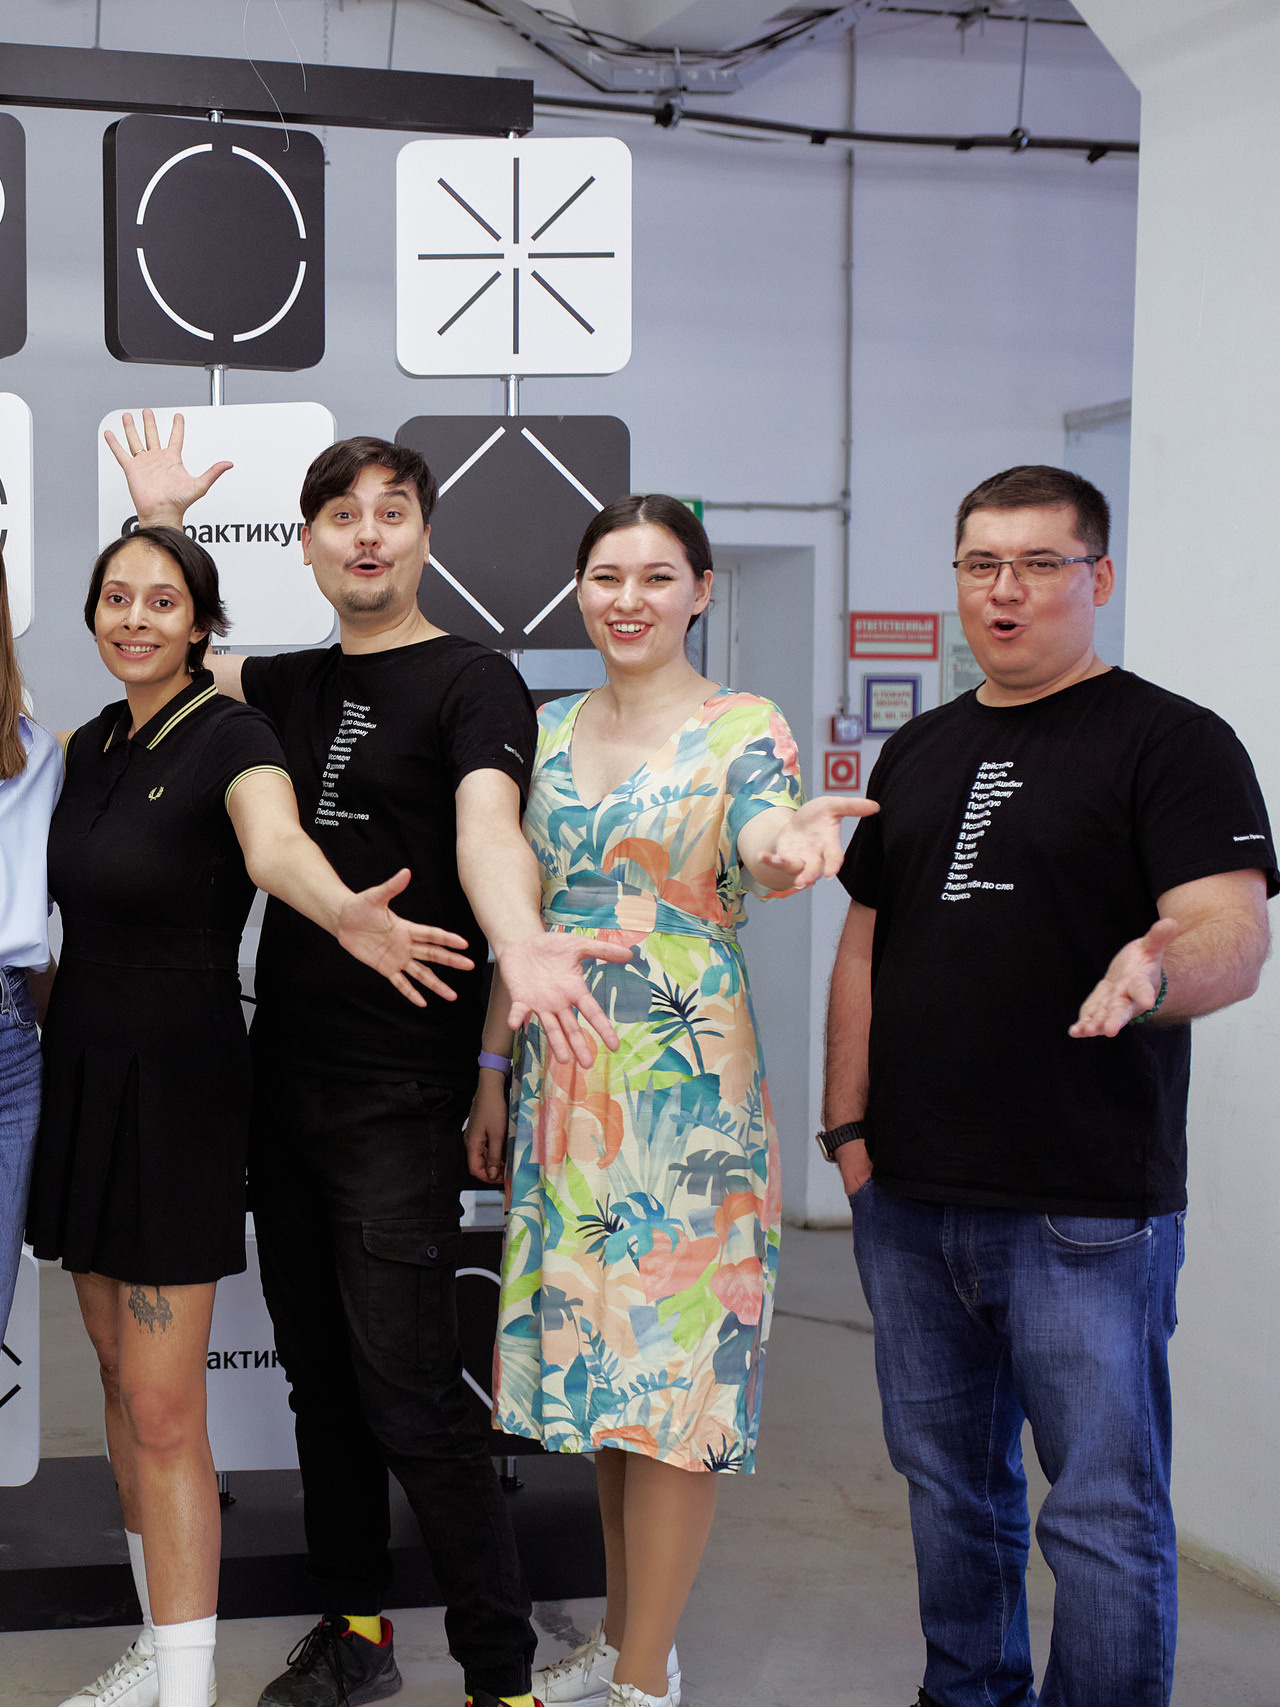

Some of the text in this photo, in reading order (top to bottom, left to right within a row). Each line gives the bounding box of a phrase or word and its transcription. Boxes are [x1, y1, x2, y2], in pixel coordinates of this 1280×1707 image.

[183, 521, 303, 547] рактику
[959, 832, 966, 840] В
[956, 842, 964, 850] В
